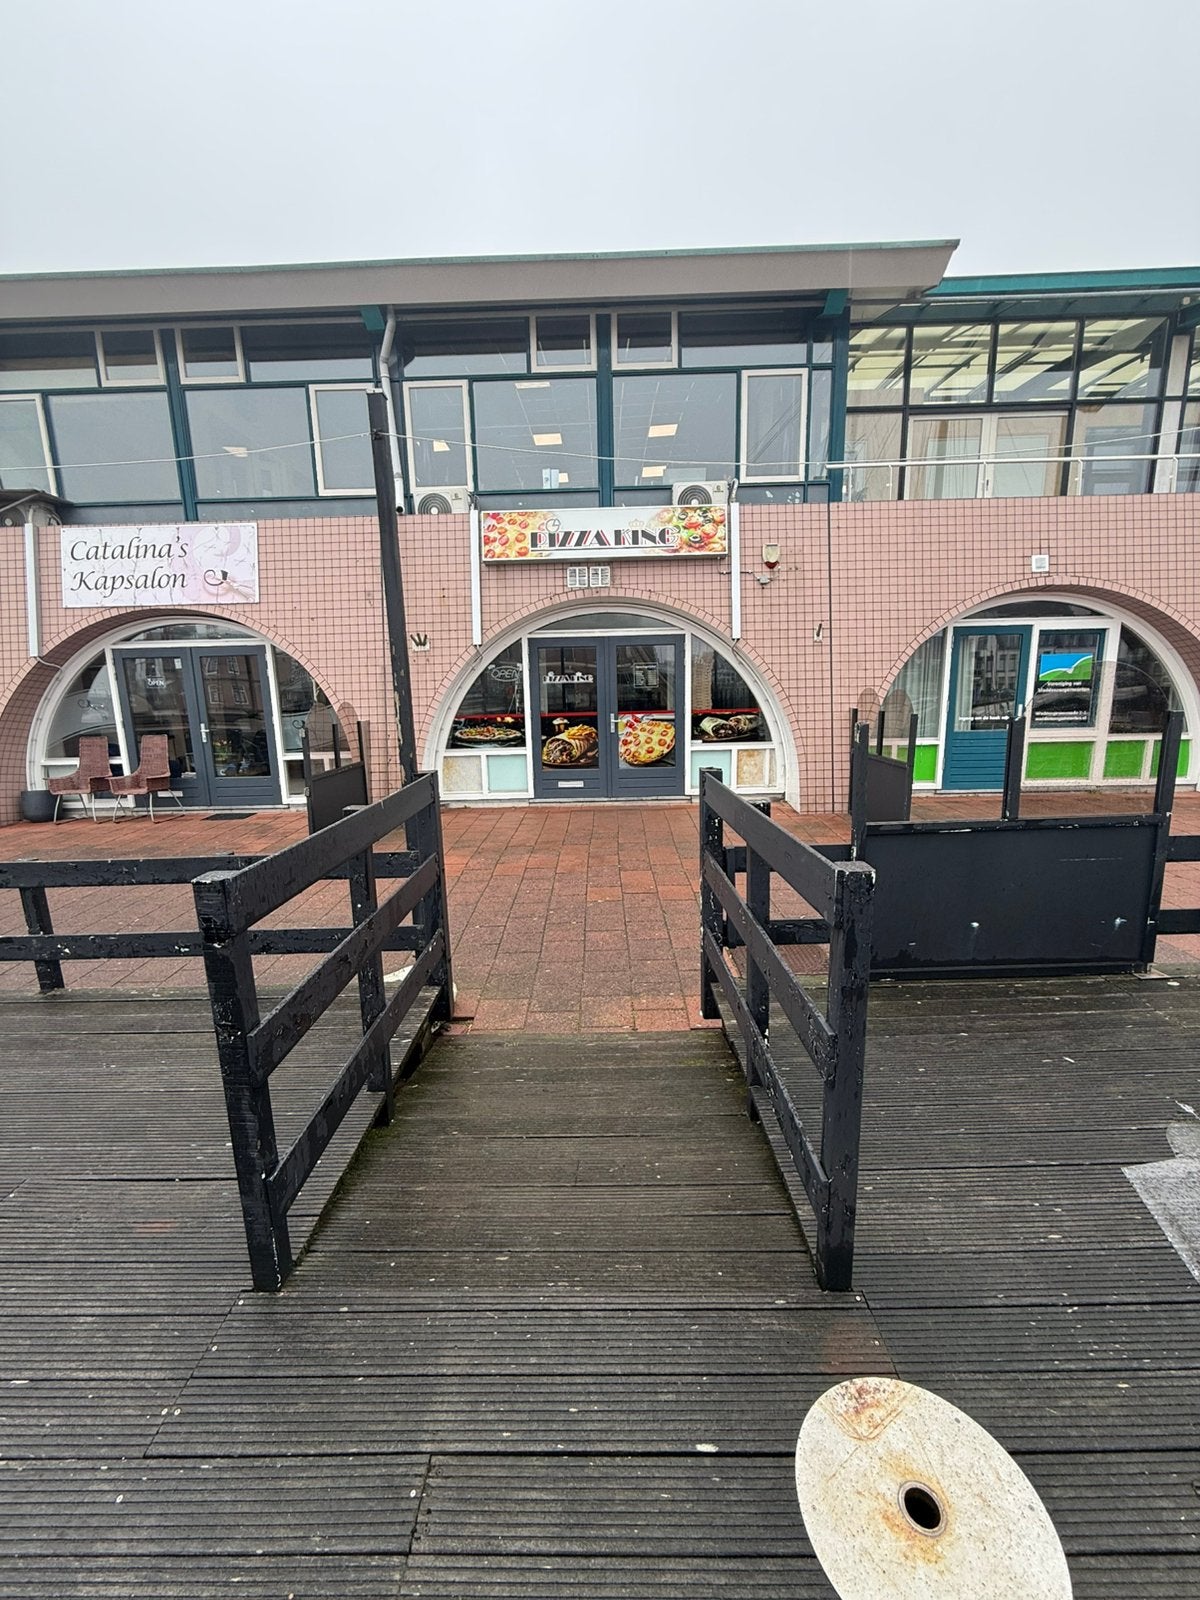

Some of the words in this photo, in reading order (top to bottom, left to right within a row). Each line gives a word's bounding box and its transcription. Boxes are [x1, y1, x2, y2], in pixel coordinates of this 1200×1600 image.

[70, 536, 189, 561] Catalina's
[530, 529, 611, 548] PIZZA
[614, 527, 680, 546] KING
[70, 566, 188, 598] Kapsalon
[492, 669, 519, 679] OPEN
